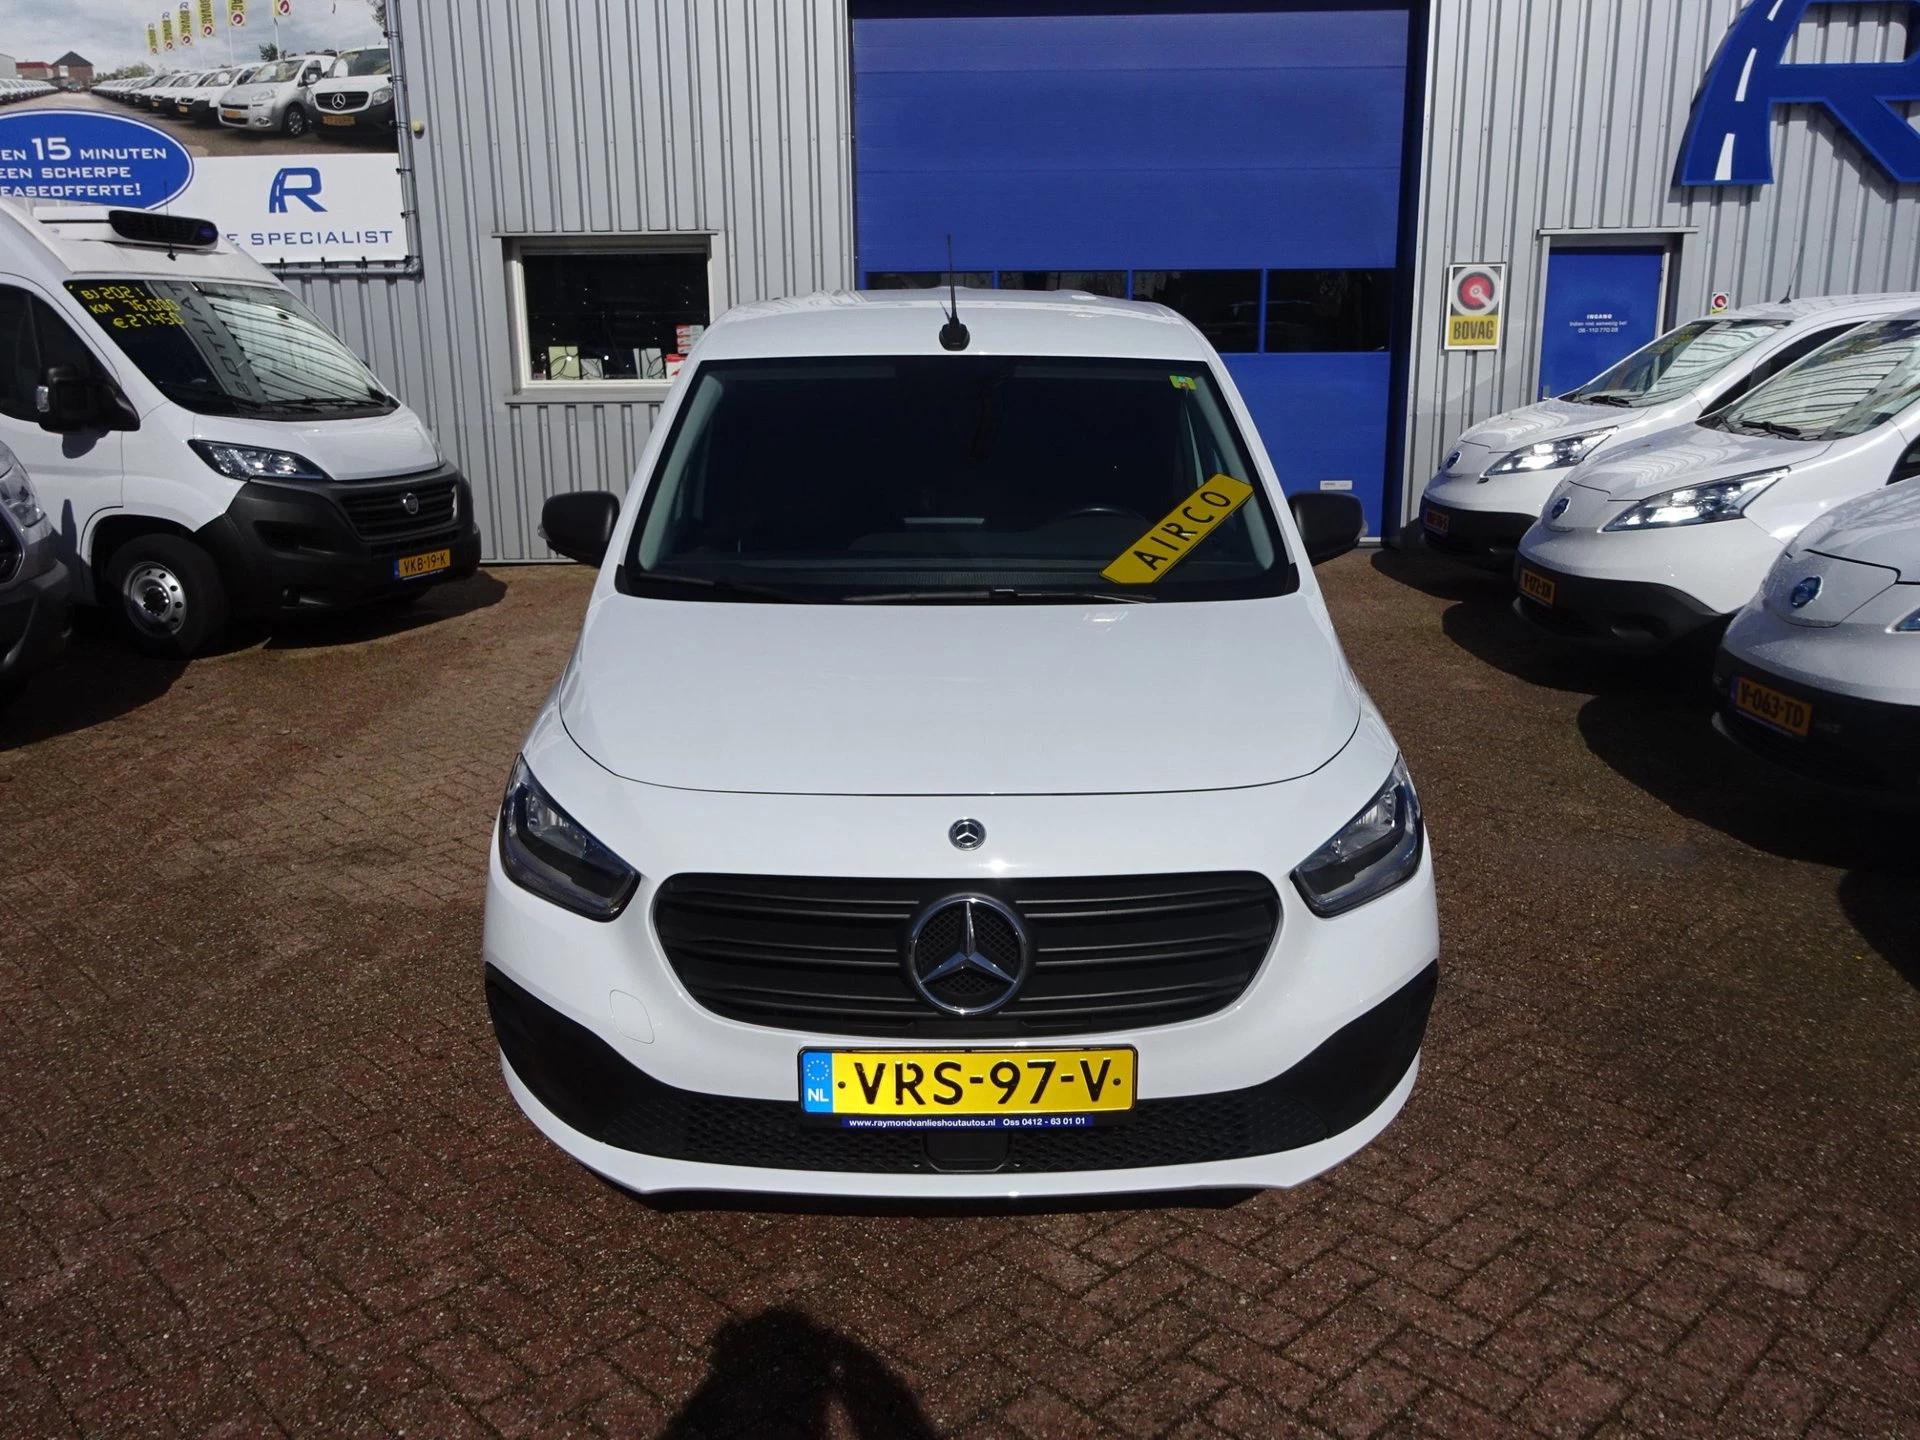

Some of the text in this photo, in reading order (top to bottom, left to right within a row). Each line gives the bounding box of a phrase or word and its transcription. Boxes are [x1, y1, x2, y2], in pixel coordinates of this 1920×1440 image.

[32, 137, 72, 161] 15
[80, 148, 167, 160] MINUTEN
[41, 166, 131, 179] SCHERPE
[251, 231, 393, 246] SPECIALIST
[89, 302, 115, 314] KM
[1453, 320, 1494, 340] BOVAG
[1132, 490, 1231, 571] AIRCO
[403, 552, 446, 573] VKB-19-K
[1741, 681, 1805, 729] V-063-TD
[807, 1058, 1112, 1106] NL VRS-97-V
[849, 1118, 996, 1128] www.raymondvanlieshoutautos.nl
[1003, 1117, 1020, 1126] Oss
[1022, 1117, 1043, 1126] 0412
[1050, 1117, 1062, 1126] 63
[1063, 1117, 1073, 1125] 01
[1075, 1117, 1086, 1125] 01
